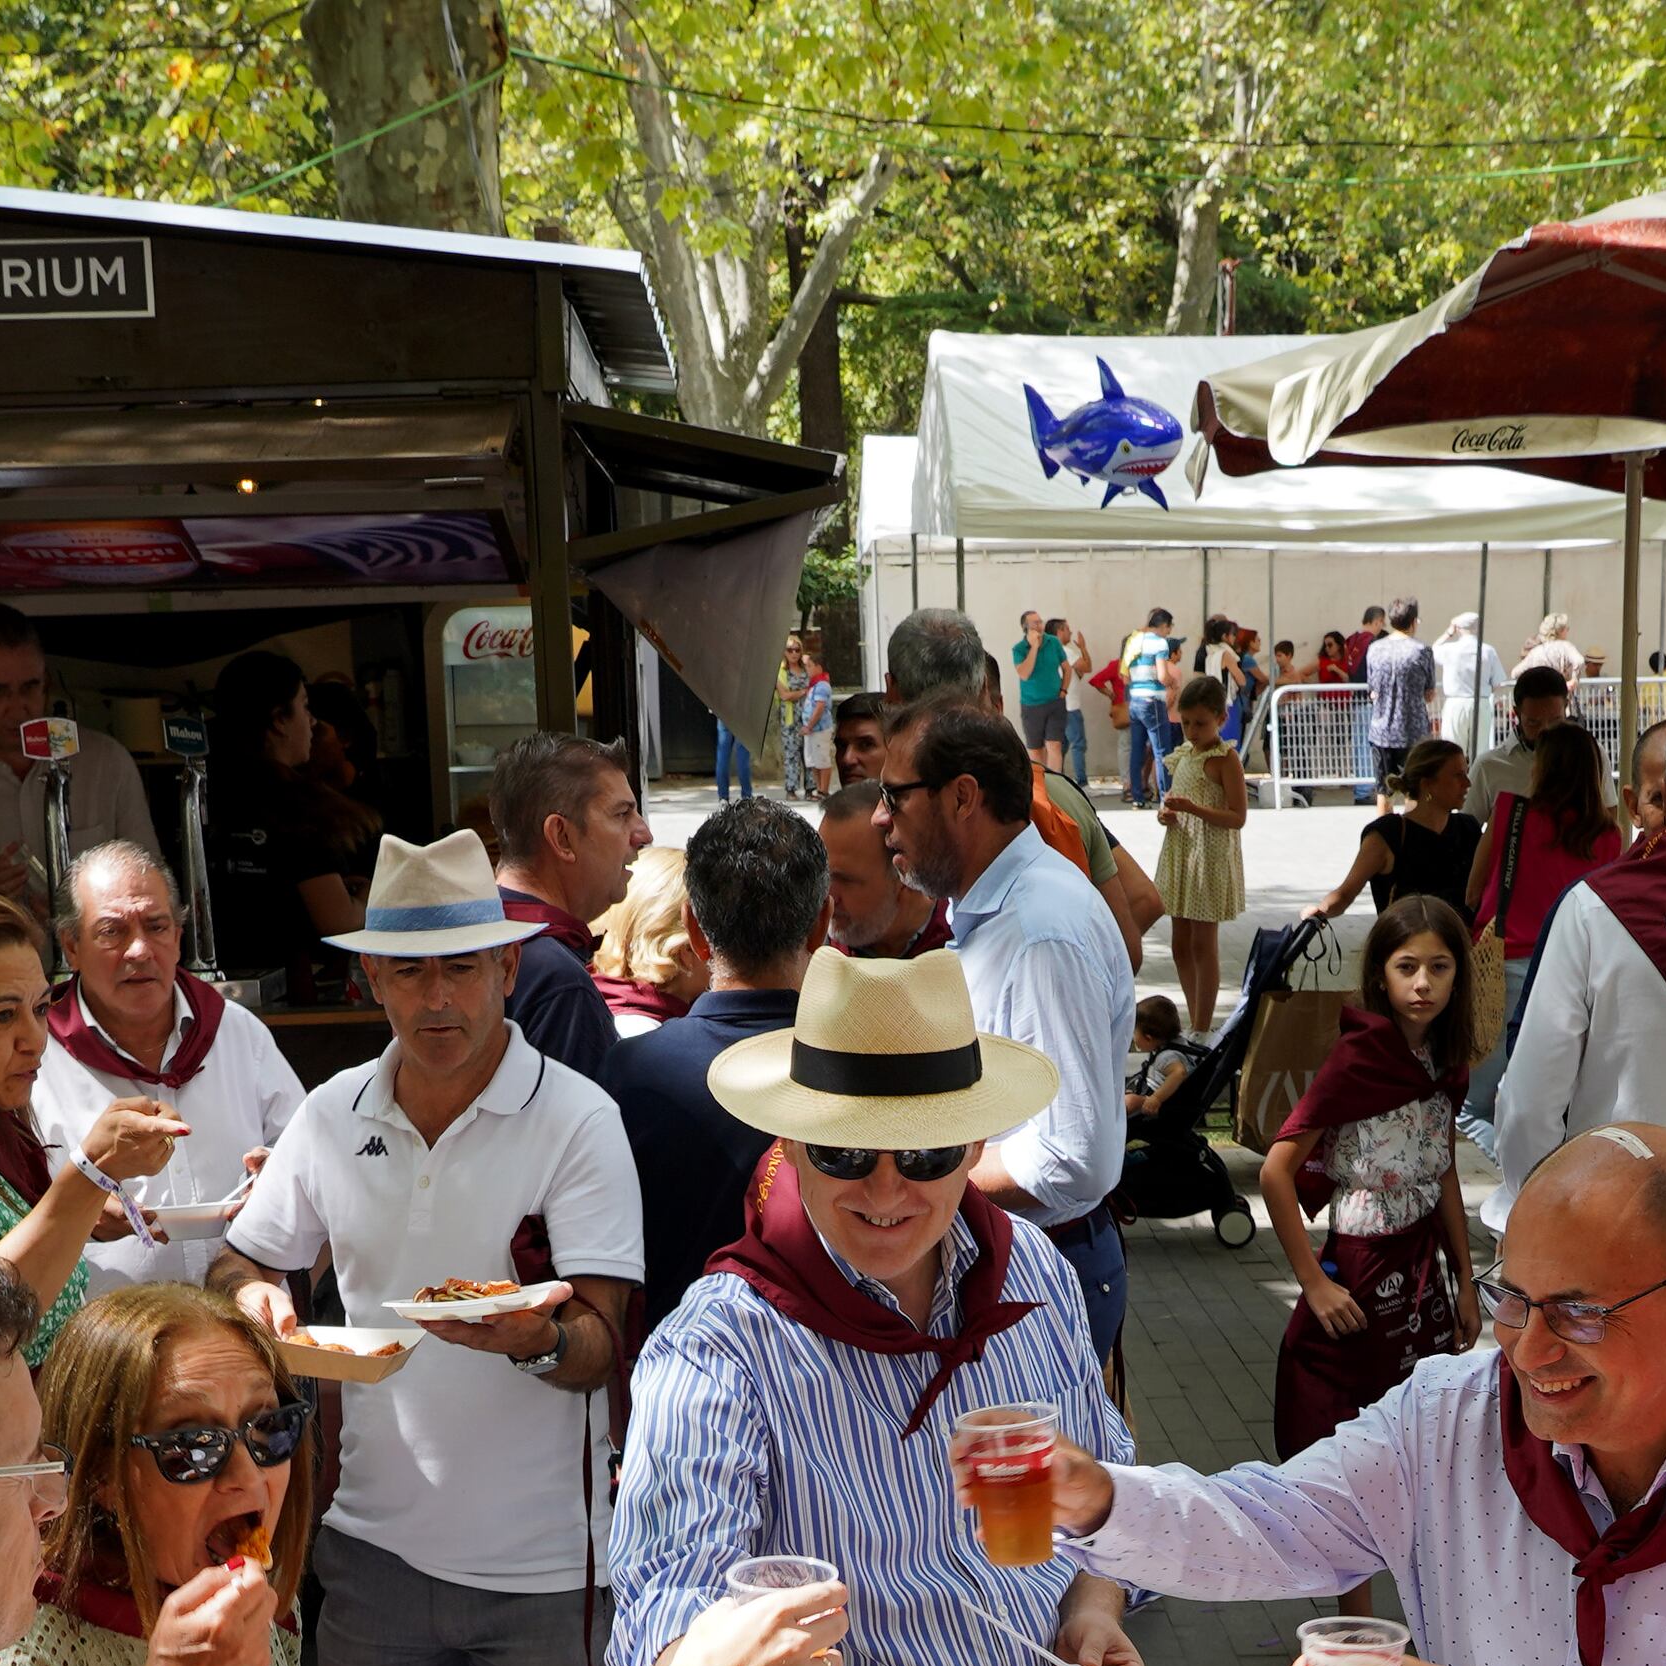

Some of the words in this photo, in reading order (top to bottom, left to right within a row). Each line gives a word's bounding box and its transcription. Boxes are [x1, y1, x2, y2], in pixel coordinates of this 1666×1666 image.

[1452, 425, 1528, 453] Coca-Cola
[25, 543, 178, 563] Mahou
[168, 725, 201, 741] Mahou
